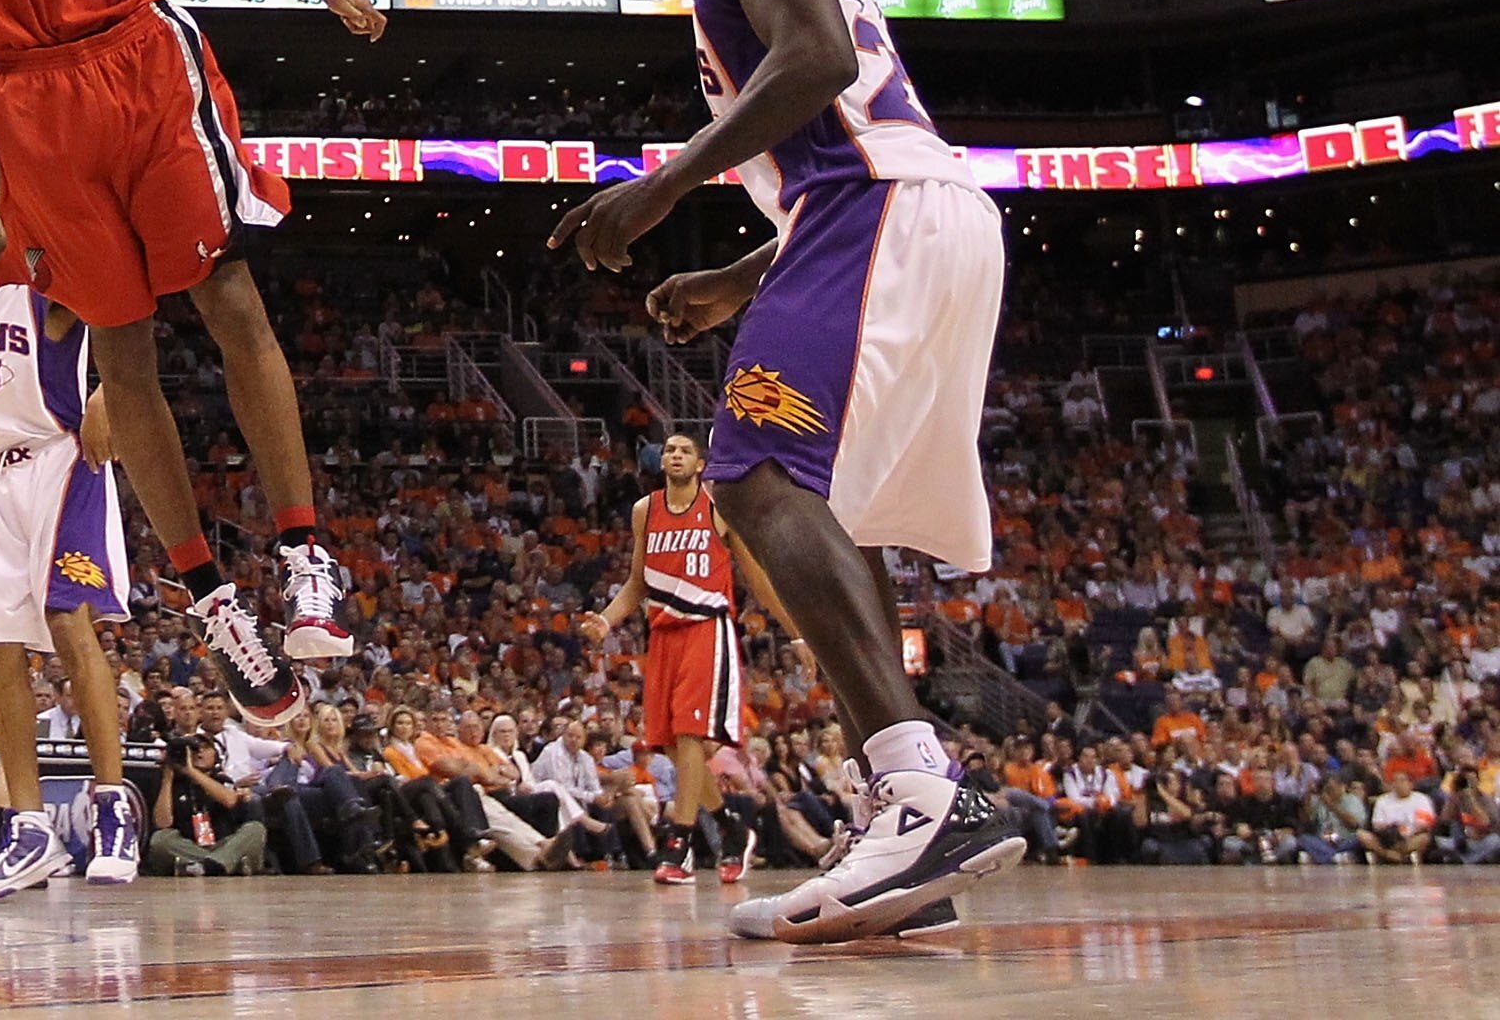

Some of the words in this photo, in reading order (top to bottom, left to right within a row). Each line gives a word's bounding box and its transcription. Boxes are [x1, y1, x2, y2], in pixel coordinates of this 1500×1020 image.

[499, 141, 596, 183] DE
[1298, 116, 1408, 173] DE
[1015, 143, 1201, 190] FENSE!
[647, 529, 711, 554] BLAZERS
[686, 553, 710, 578] 88
